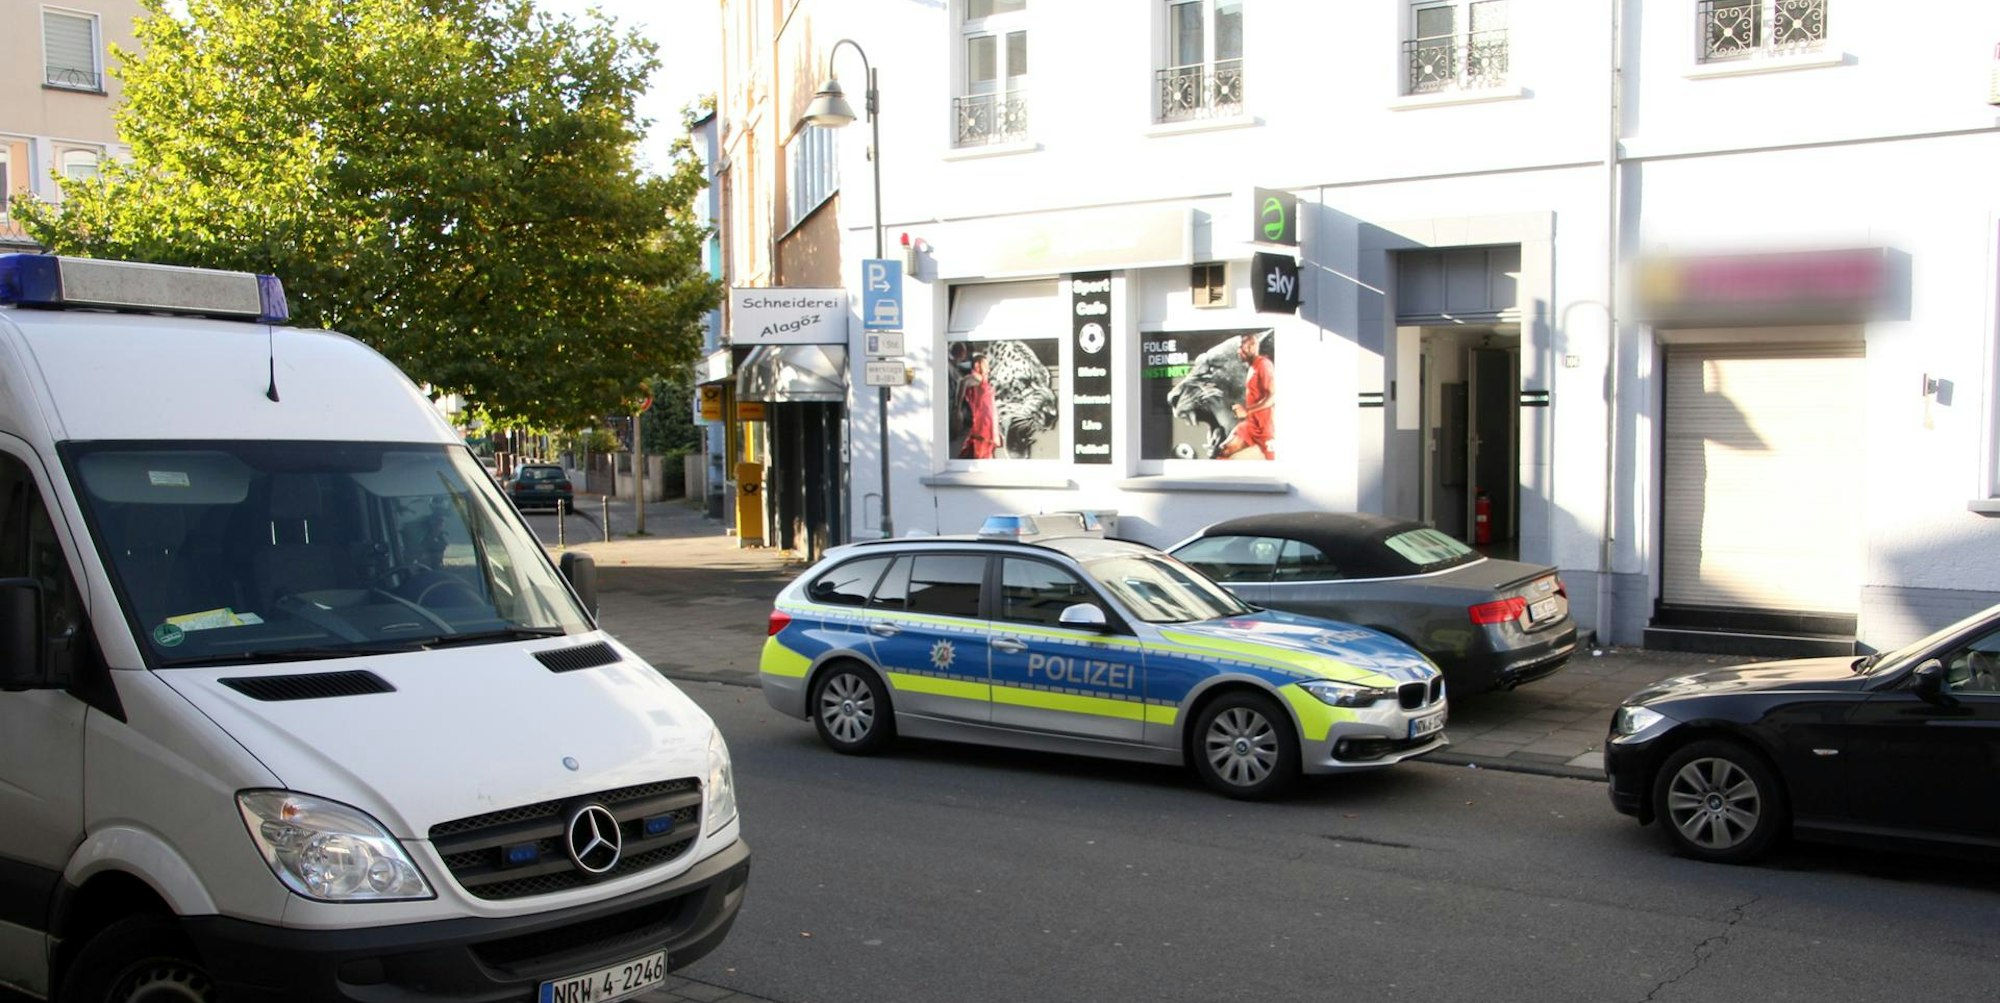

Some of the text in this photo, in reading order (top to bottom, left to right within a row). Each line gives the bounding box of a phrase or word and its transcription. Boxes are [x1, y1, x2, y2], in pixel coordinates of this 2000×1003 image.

[868, 263, 886, 292] P
[1267, 266, 1295, 301] sky
[1073, 278, 1110, 296] Sport
[742, 297, 838, 309] Schneiderei
[760, 314, 822, 338] Alagöz
[1143, 340, 1177, 352] FOLGE
[1148, 352, 1189, 365] DEINEM
[1142, 366, 1193, 378] INSTINKT
[1082, 420, 1103, 430] Live
[1028, 653, 1135, 689] POLIZEI
[553, 956, 664, 1003] NRW 4-2246
